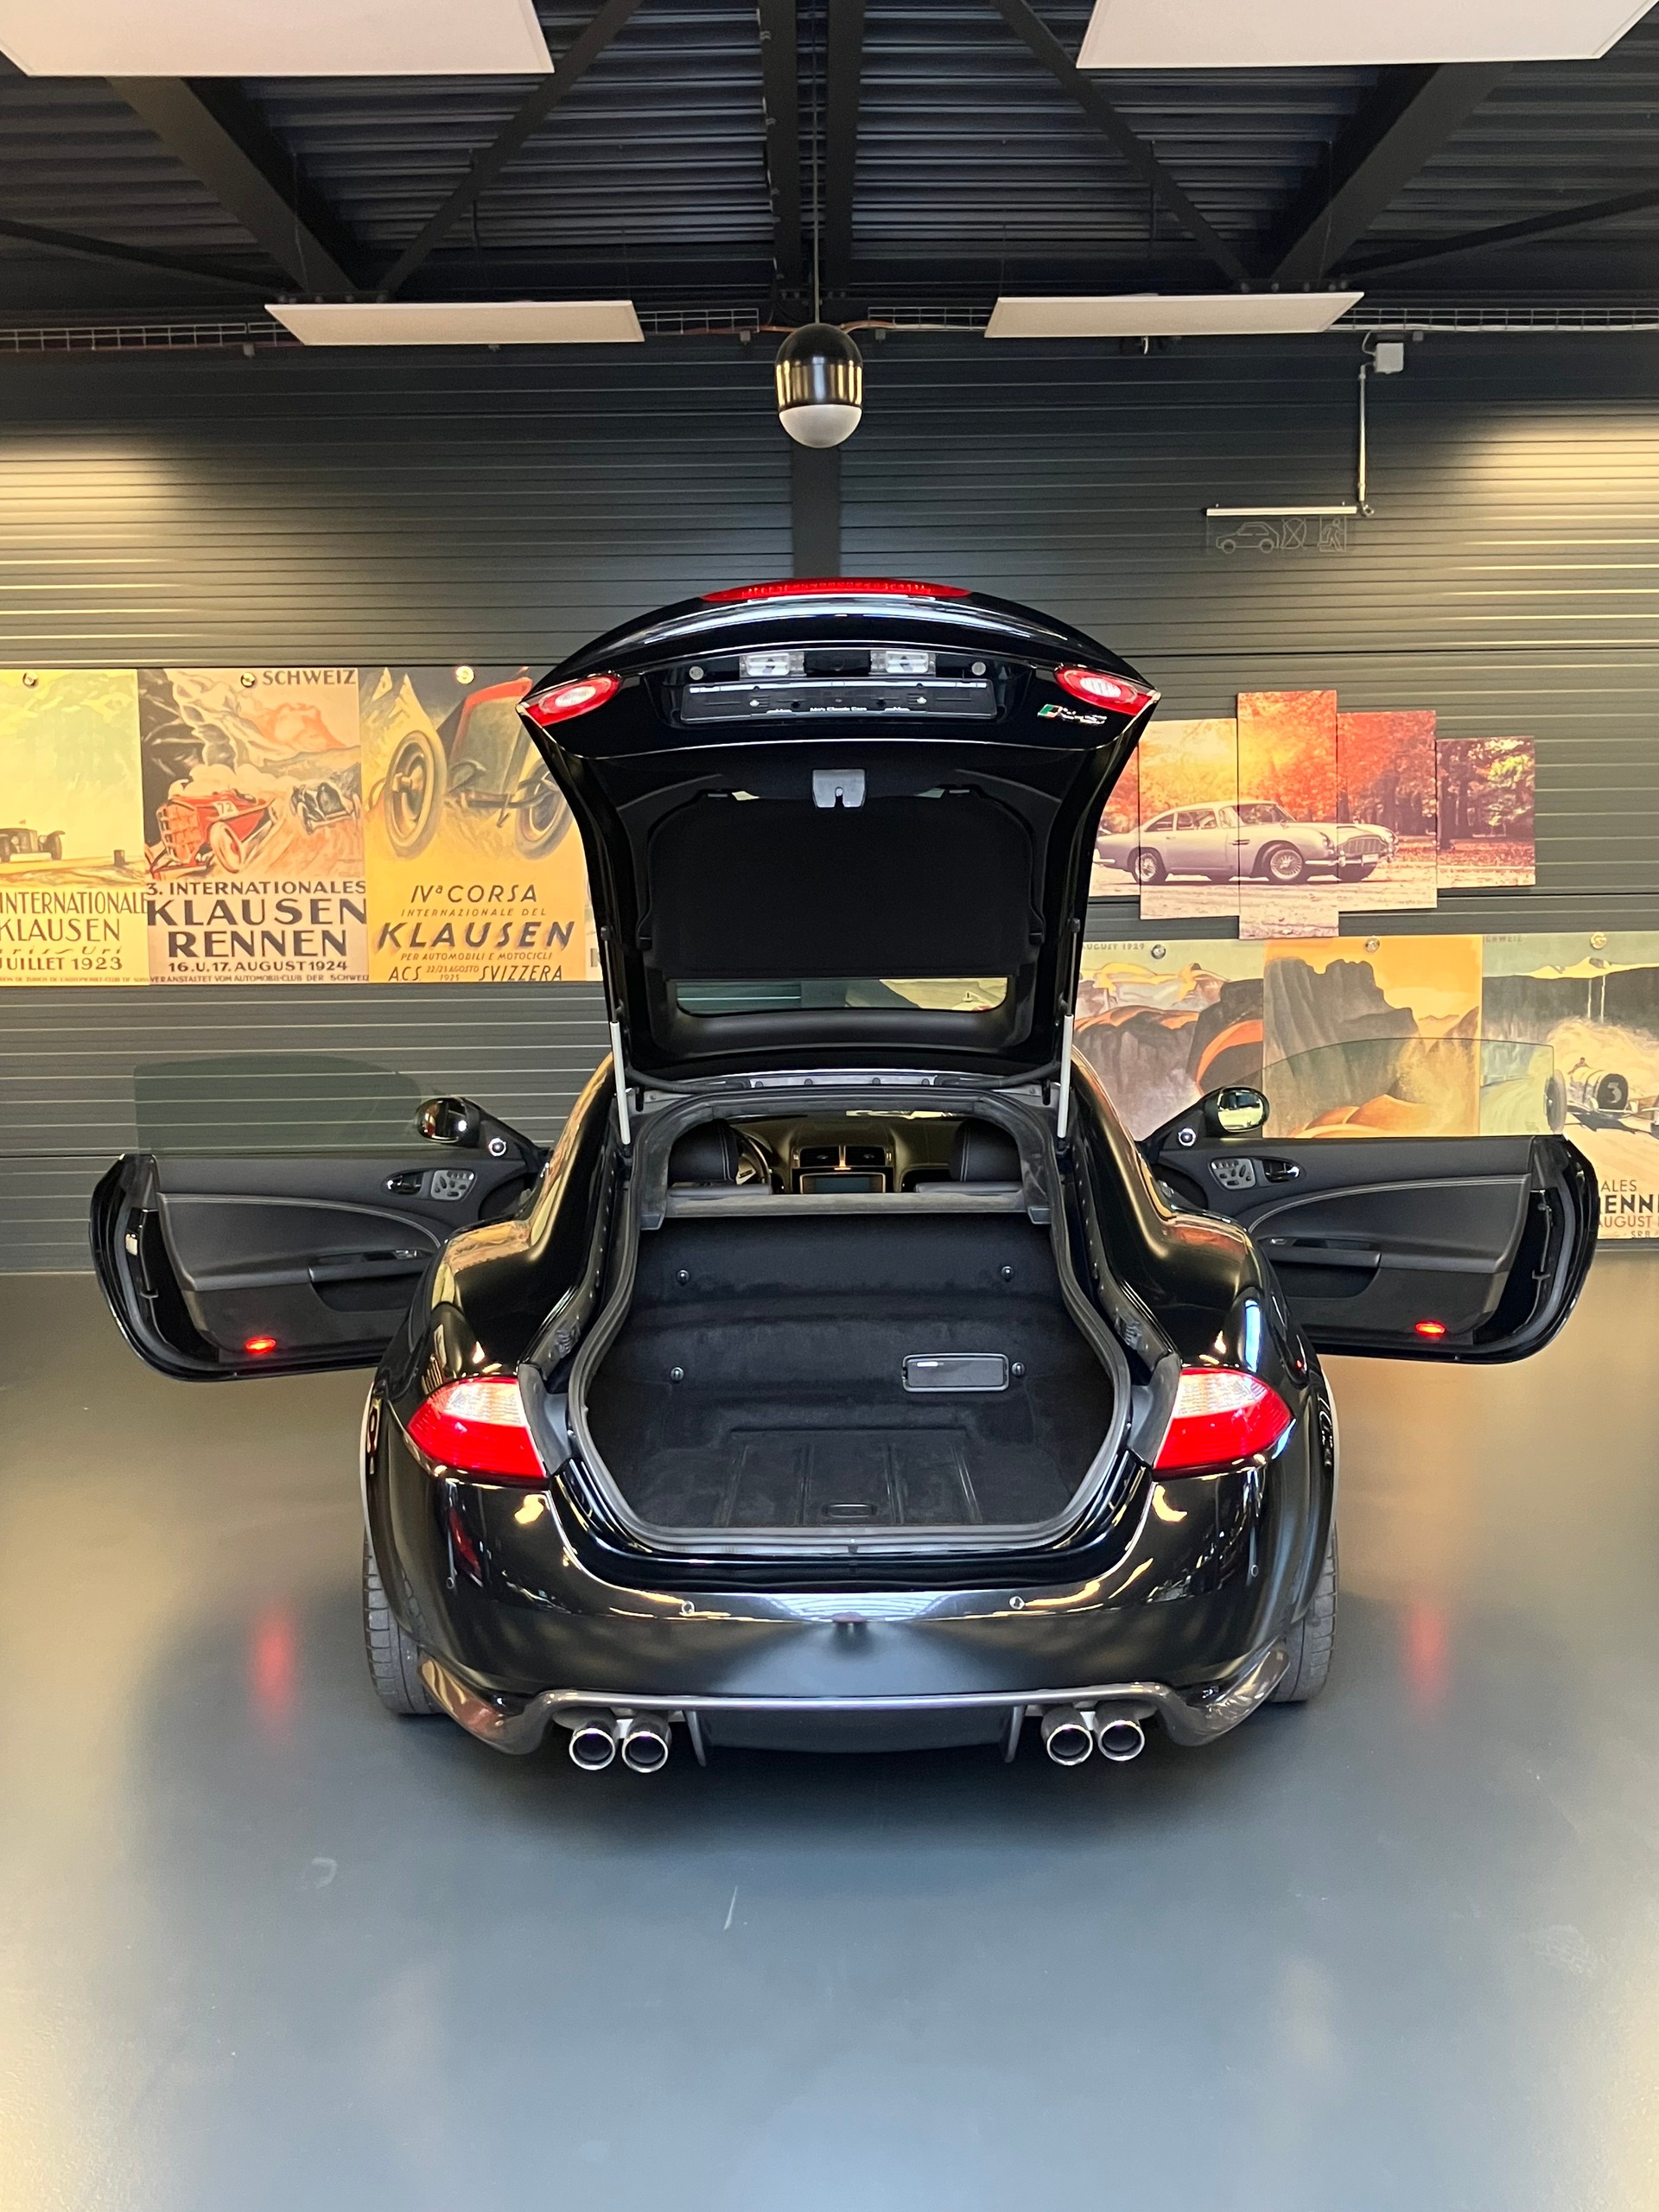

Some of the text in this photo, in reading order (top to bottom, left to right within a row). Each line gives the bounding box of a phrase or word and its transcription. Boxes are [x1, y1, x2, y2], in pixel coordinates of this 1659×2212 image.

[263, 670, 356, 685] SCHWEIZ
[217, 803, 233, 814] 72
[146, 880, 366, 895] 3. INTERNATIONALES
[448, 884, 537, 903] CORSA
[148, 898, 367, 926] KLAUSEN
[401, 908, 514, 917] INTERNAZIONALE
[0, 918, 120, 942] KLAUSEN
[378, 921, 575, 950] KLAUSEN
[168, 929, 346, 958] RENNEN
[72, 957, 123, 970] 1923
[423, 952, 485, 961] AUTOMOBILI
[497, 951, 553, 960] MOTOCICLI
[234, 961, 306, 971] AUGUST
[308, 960, 347, 971] 1924
[479, 965, 563, 982] SVIZZERA
[1607, 1082, 1623, 1103] 3
[1604, 1193, 1659, 1214] ENN
